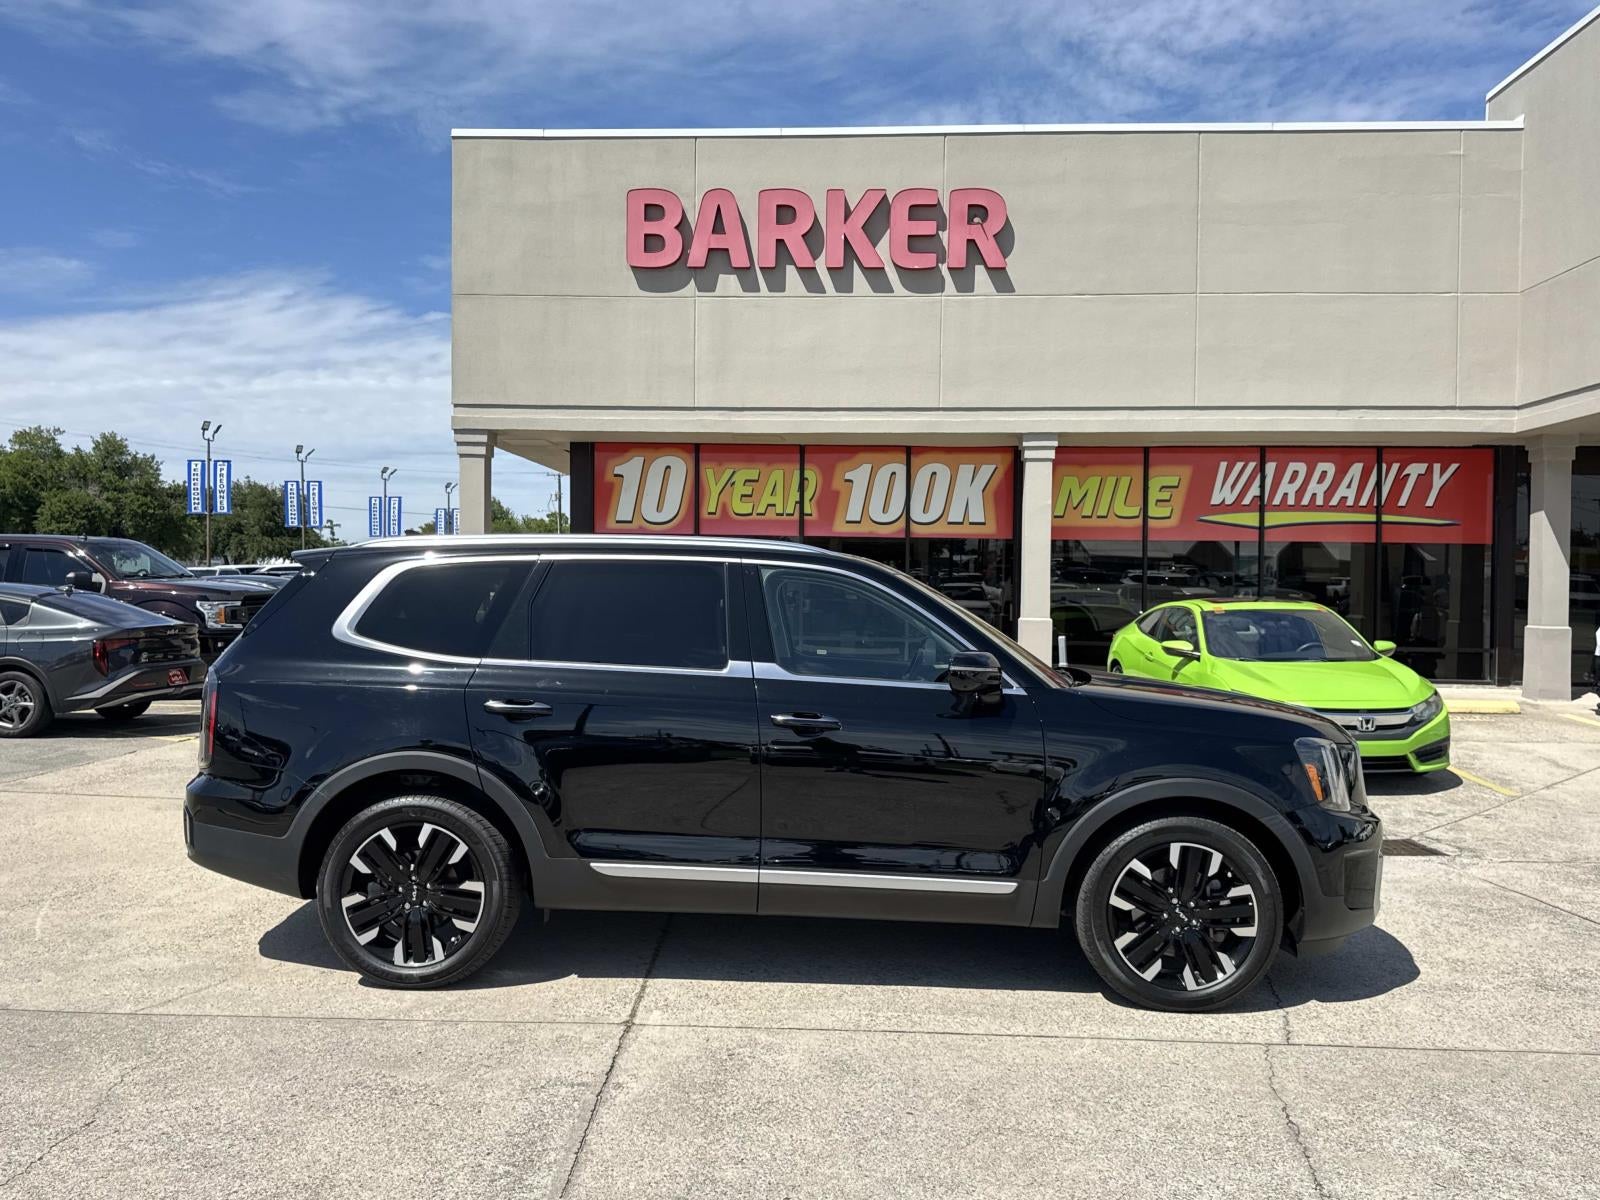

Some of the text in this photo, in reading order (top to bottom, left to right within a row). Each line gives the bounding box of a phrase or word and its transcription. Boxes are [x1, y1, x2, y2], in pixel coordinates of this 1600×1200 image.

[626, 188, 1008, 270] BARKER
[218, 467, 226, 511] PREOWNED
[613, 455, 1461, 525] 10 YEAR 100K MILE WARRANTY
